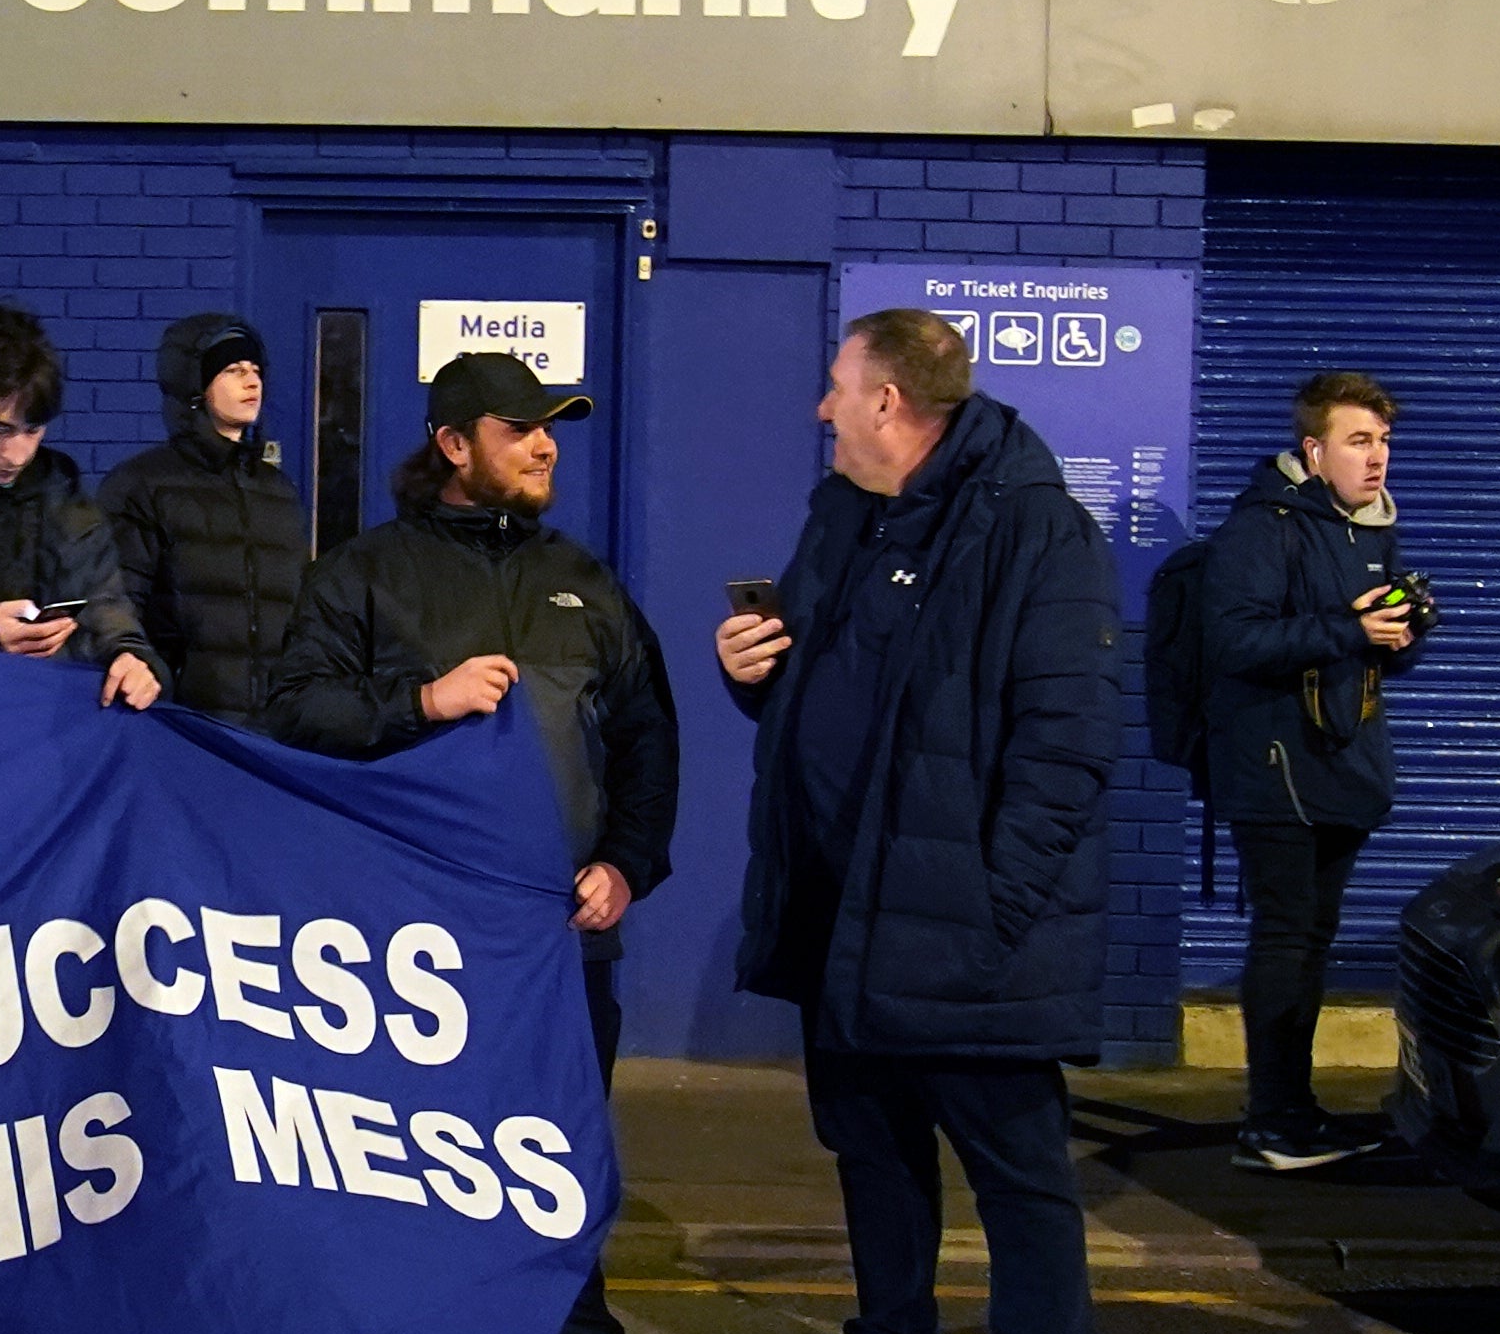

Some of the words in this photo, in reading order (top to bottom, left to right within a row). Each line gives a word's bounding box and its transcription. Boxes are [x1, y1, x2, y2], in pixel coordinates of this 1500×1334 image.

[926, 278, 955, 297] For
[960, 279, 1017, 298] Ticket
[1022, 280, 1109, 301] Enquiries
[460, 314, 546, 339] Media
[212, 1065, 588, 1241] MESS
